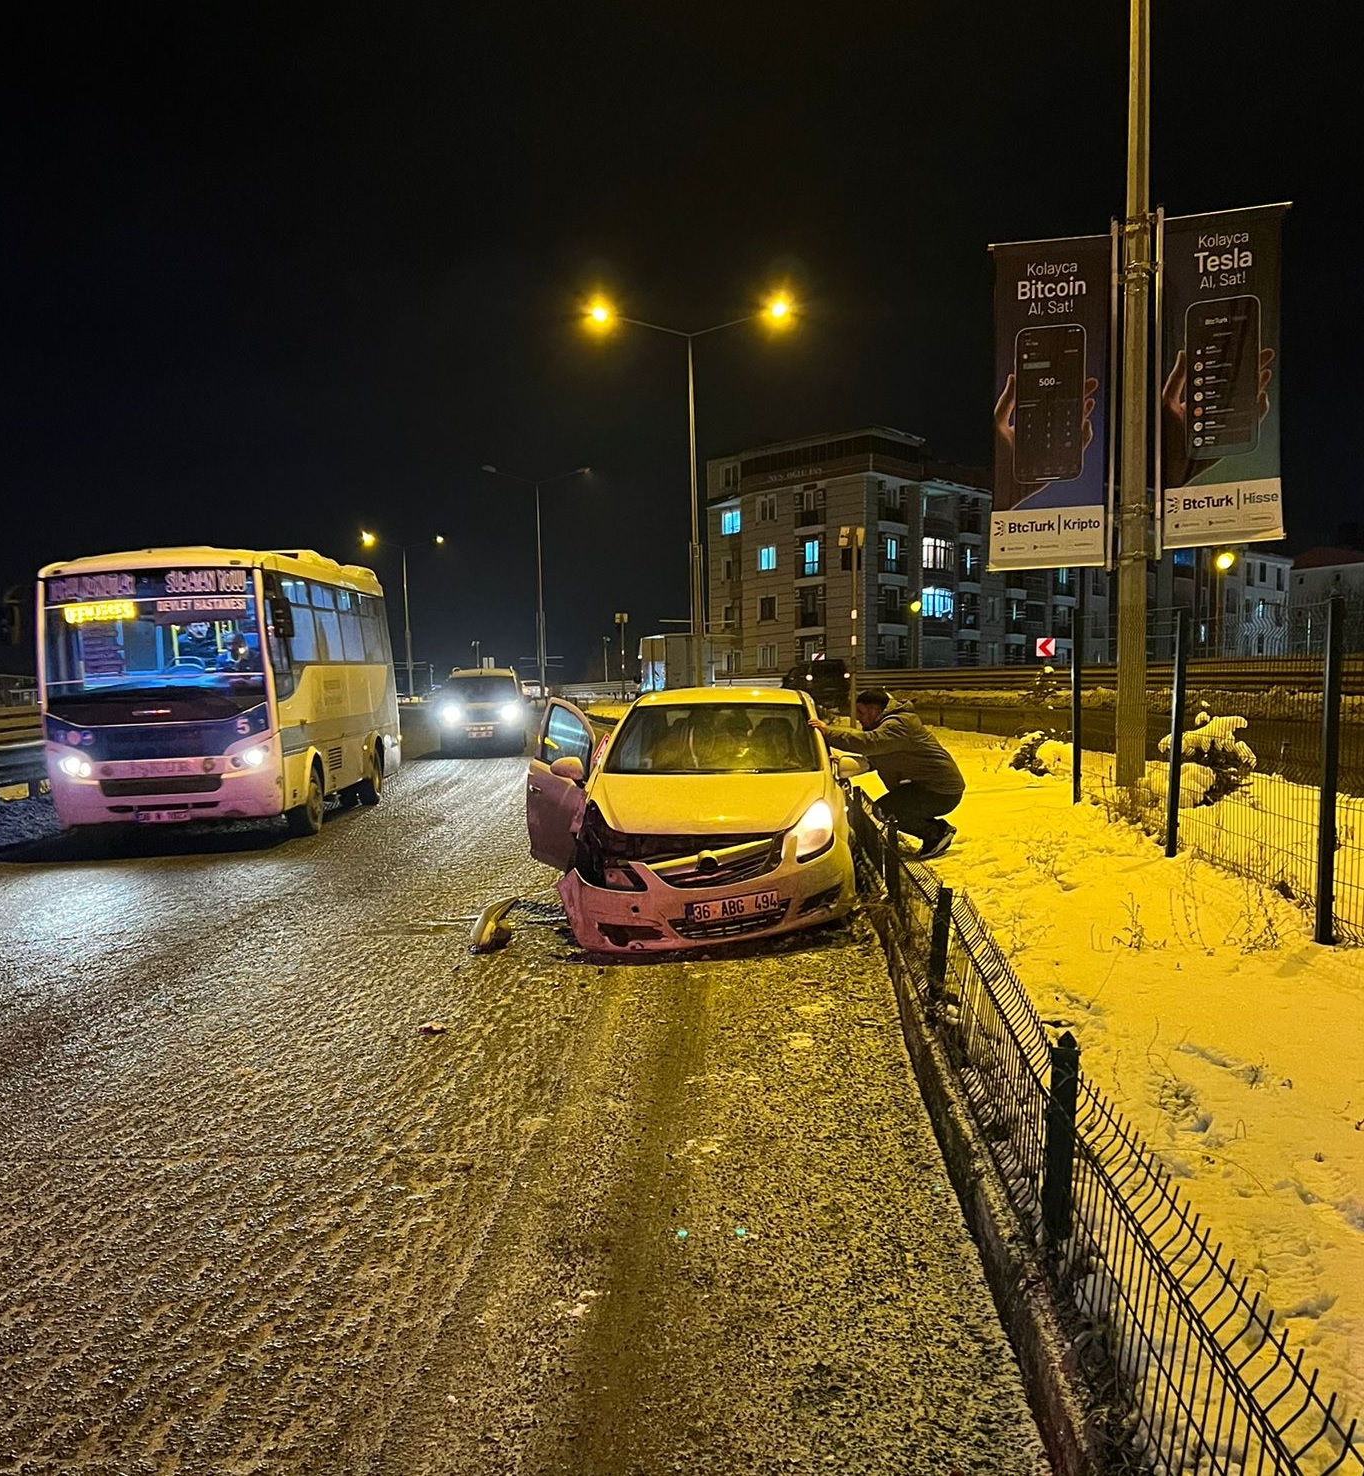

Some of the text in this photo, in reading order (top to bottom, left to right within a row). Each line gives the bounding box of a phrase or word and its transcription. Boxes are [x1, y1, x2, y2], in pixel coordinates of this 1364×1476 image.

[1198, 232, 1249, 249] Kolayca
[1194, 247, 1253, 273] Tesla
[1027, 261, 1078, 278] Kolayca
[1017, 275, 1087, 300] Bitcoin
[1199, 270, 1246, 290] Al, Sat!
[1027, 299, 1074, 316] Al, Sat!
[1038, 377, 1056, 387] 500
[1183, 491, 1279, 511] BtcTurk Hisse
[1008, 518, 1100, 534] BtcTurk Kripto
[157, 600, 192, 612] DEVLET
[237, 718, 250, 734] 5
[694, 894, 778, 920] 36 ABG 494
